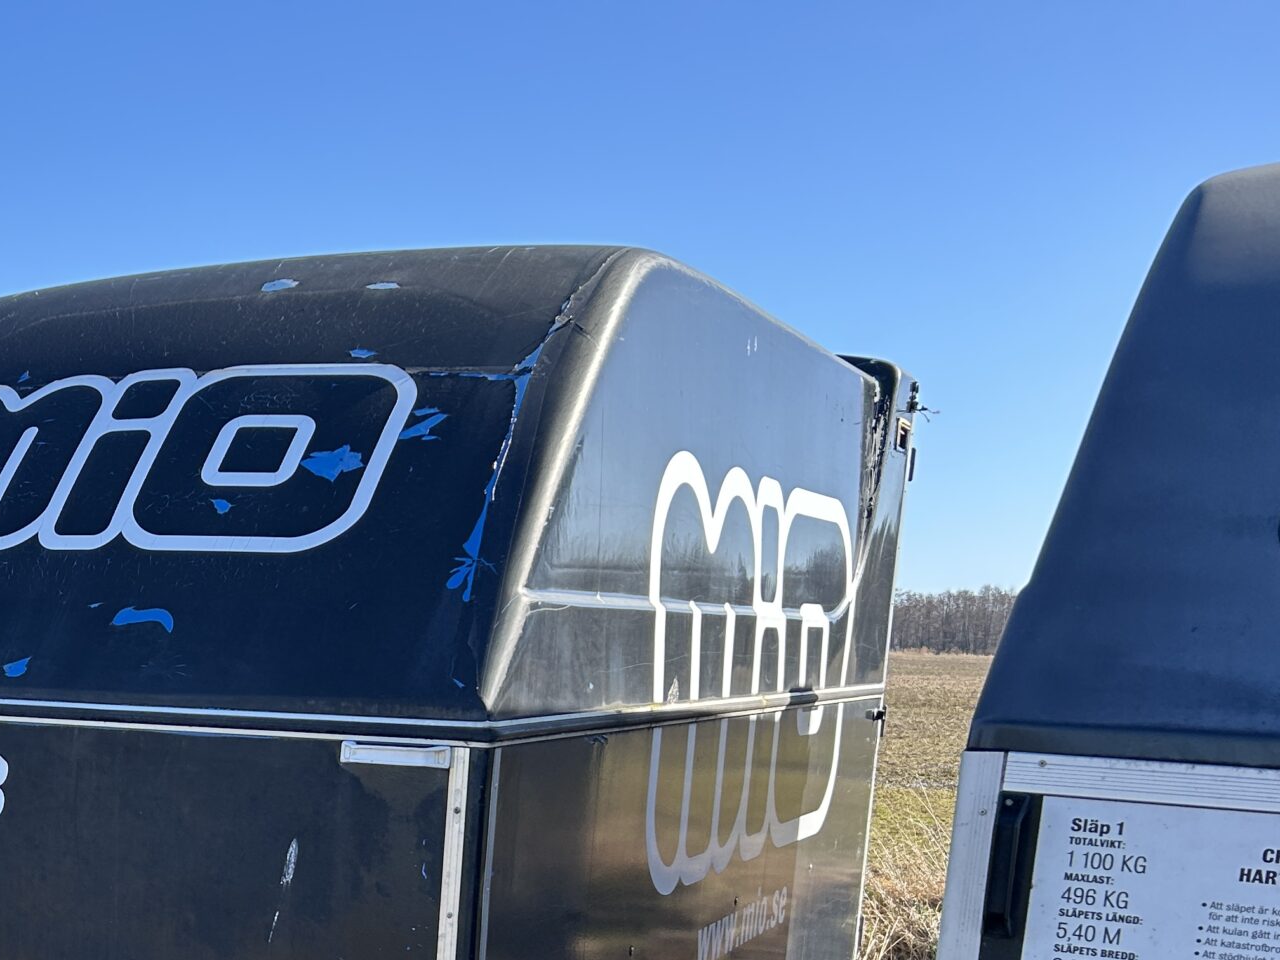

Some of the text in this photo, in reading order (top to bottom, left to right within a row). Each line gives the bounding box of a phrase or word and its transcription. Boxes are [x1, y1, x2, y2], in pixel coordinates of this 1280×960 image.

[1070, 818, 1124, 837] Släp 1
[1068, 836, 1126, 849] TOTALVIKT:
[1082, 852, 1114, 871] 100
[1120, 855, 1147, 874] KG
[1063, 872, 1115, 885] MAXLAST:
[1238, 867, 1278, 885] HAR
[1061, 886, 1129, 909] 496 KG
[1209, 901, 1223, 911] Att
[1225, 903, 1256, 913] släpet
[1258, 906, 1269, 915] är
[1058, 907, 1143, 925] SLÄPETS LÄNGD:
[1208, 911, 1223, 921] för
[1225, 914, 1239, 923] att
[1241, 916, 1260, 925] inte
[1056, 922, 1121, 945] 5,40 M
[1206, 924, 1220, 934] Att
[1222, 926, 1249, 937] kulan
[1251, 929, 1271, 939] gått
[1204, 937, 1218, 947] Att
[1053, 943, 1098, 957] SLÄPETS
[1202, 950, 1216, 959] Att
